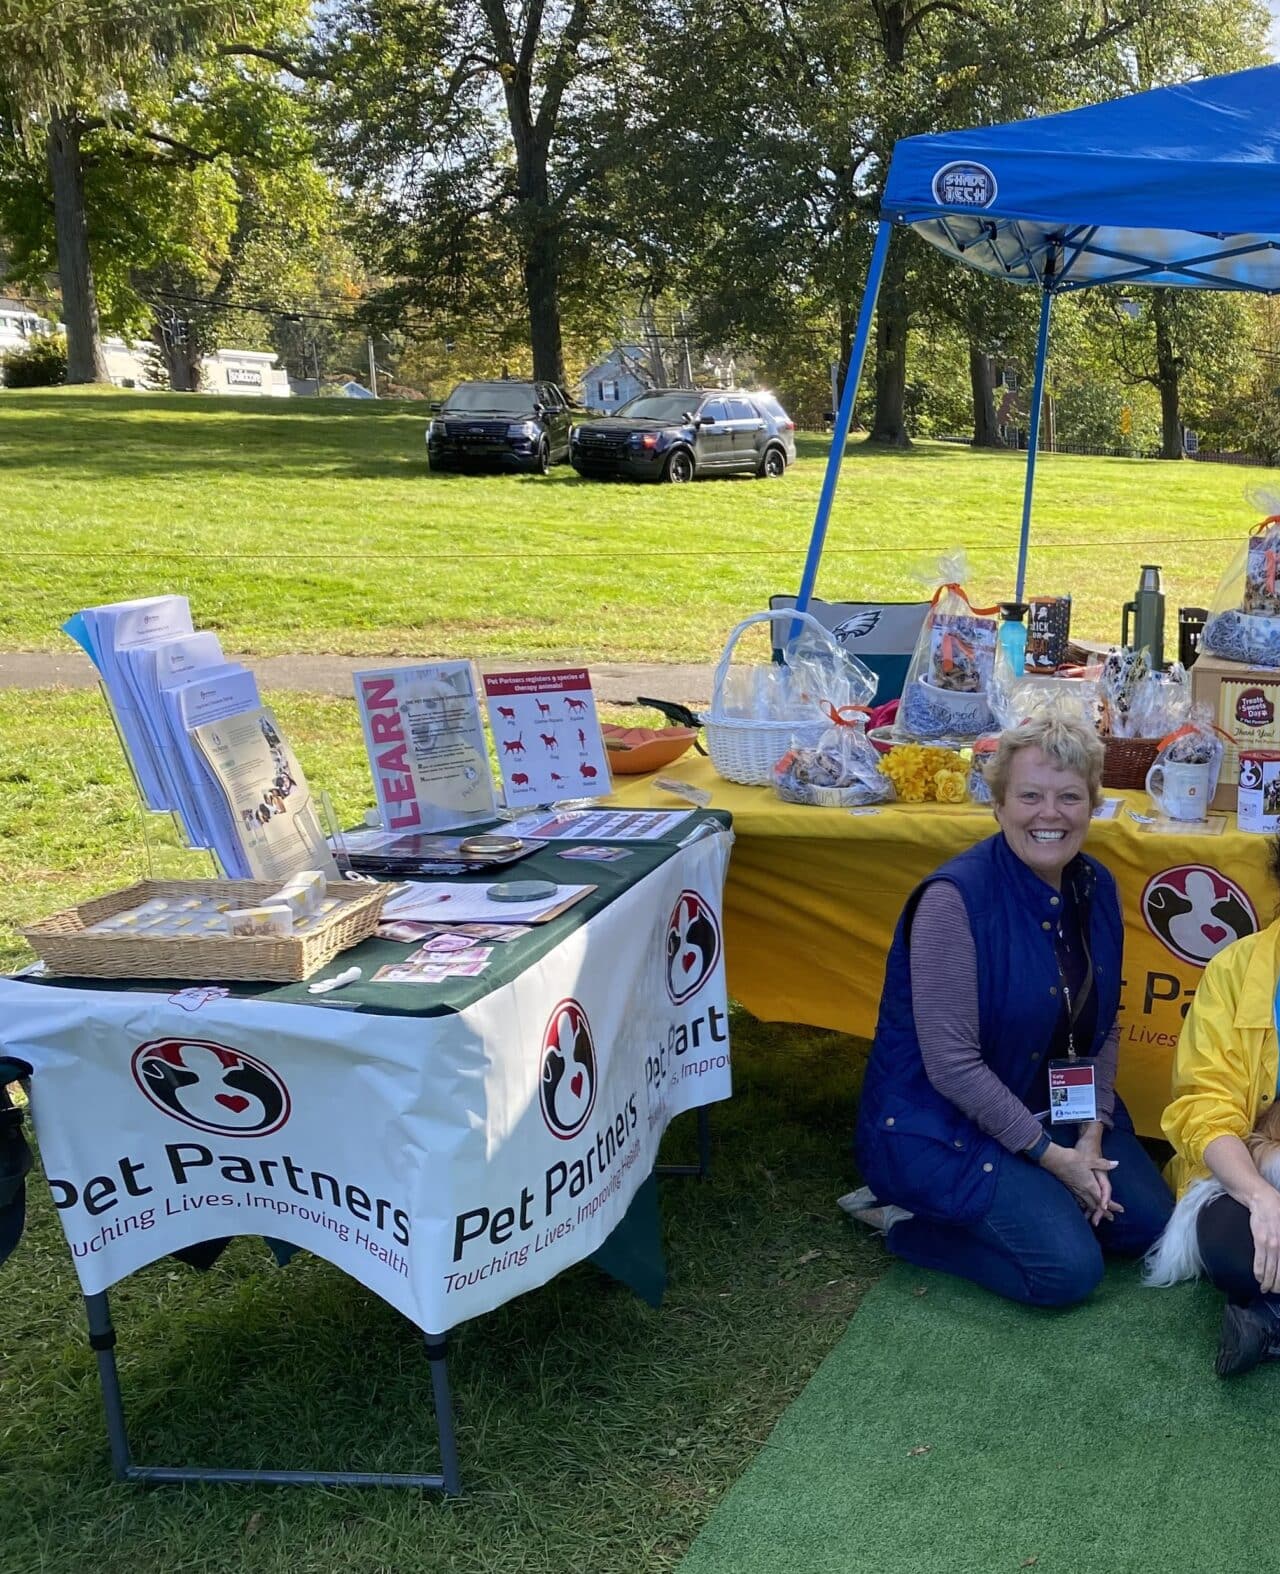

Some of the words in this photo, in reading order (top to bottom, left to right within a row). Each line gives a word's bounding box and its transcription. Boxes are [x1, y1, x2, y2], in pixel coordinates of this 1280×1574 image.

[945, 174, 985, 187] SHADE
[946, 187, 985, 202] TECH
[499, 676, 525, 684] Partners
[525, 675, 553, 684] registers
[557, 674, 579, 682] species
[1242, 697, 1264, 705] Treats
[1242, 703, 1266, 712] Sweets
[363, 679, 421, 829] LEARN
[165, 1143, 411, 1247] Partners
[453, 1186, 535, 1263] Pet
[545, 1094, 638, 1217] Partners
[165, 1193, 241, 1216] Lives,
[246, 1192, 350, 1242] Improving
[355, 1228, 409, 1278] Health
[444, 1243, 530, 1294] Touching
[534, 1217, 576, 1253] Lives,
[577, 1170, 622, 1225] Improving
